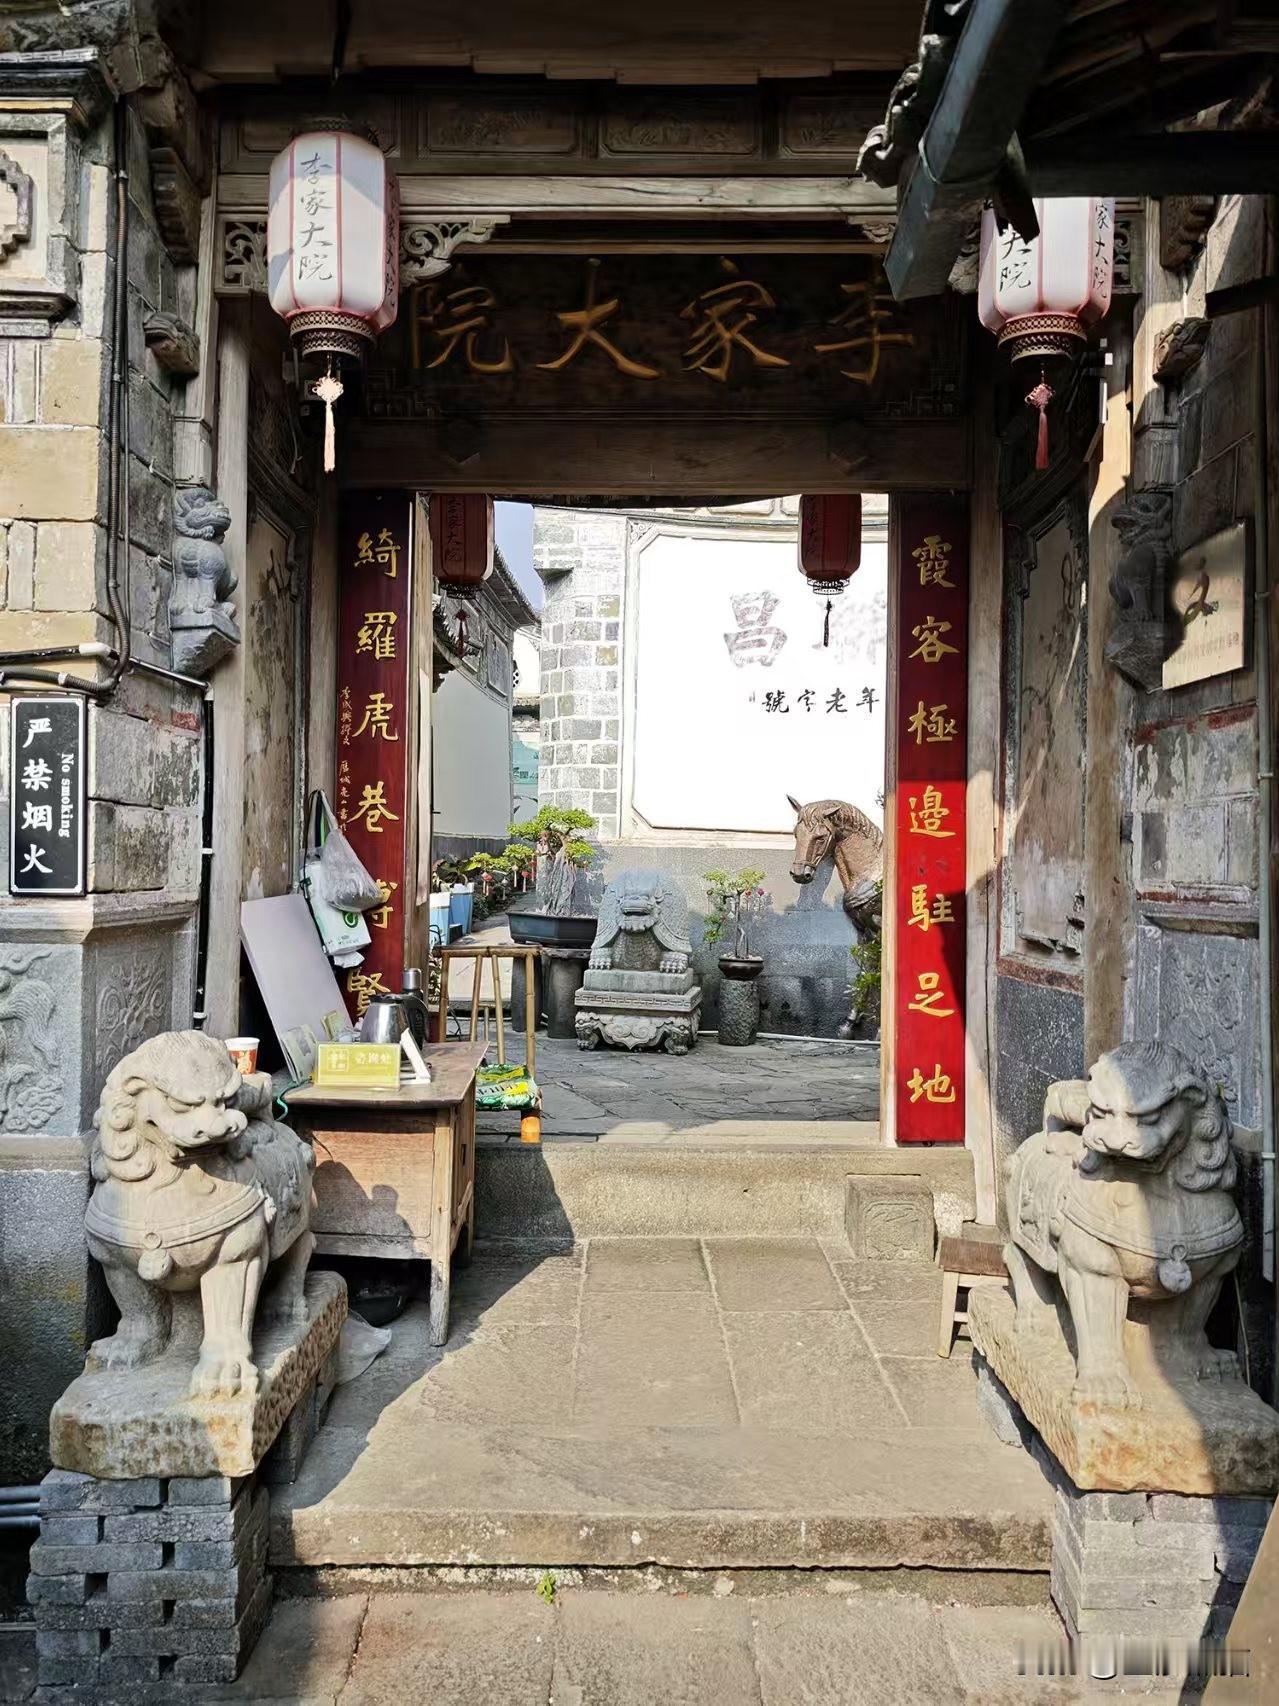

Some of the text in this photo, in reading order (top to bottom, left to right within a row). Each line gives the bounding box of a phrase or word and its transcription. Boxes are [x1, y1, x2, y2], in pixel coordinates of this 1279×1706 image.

[299, 153, 333, 281] 李家大院
[20, 718, 53, 874] 严禁烟火
[59, 753, 75, 838] No smoking
